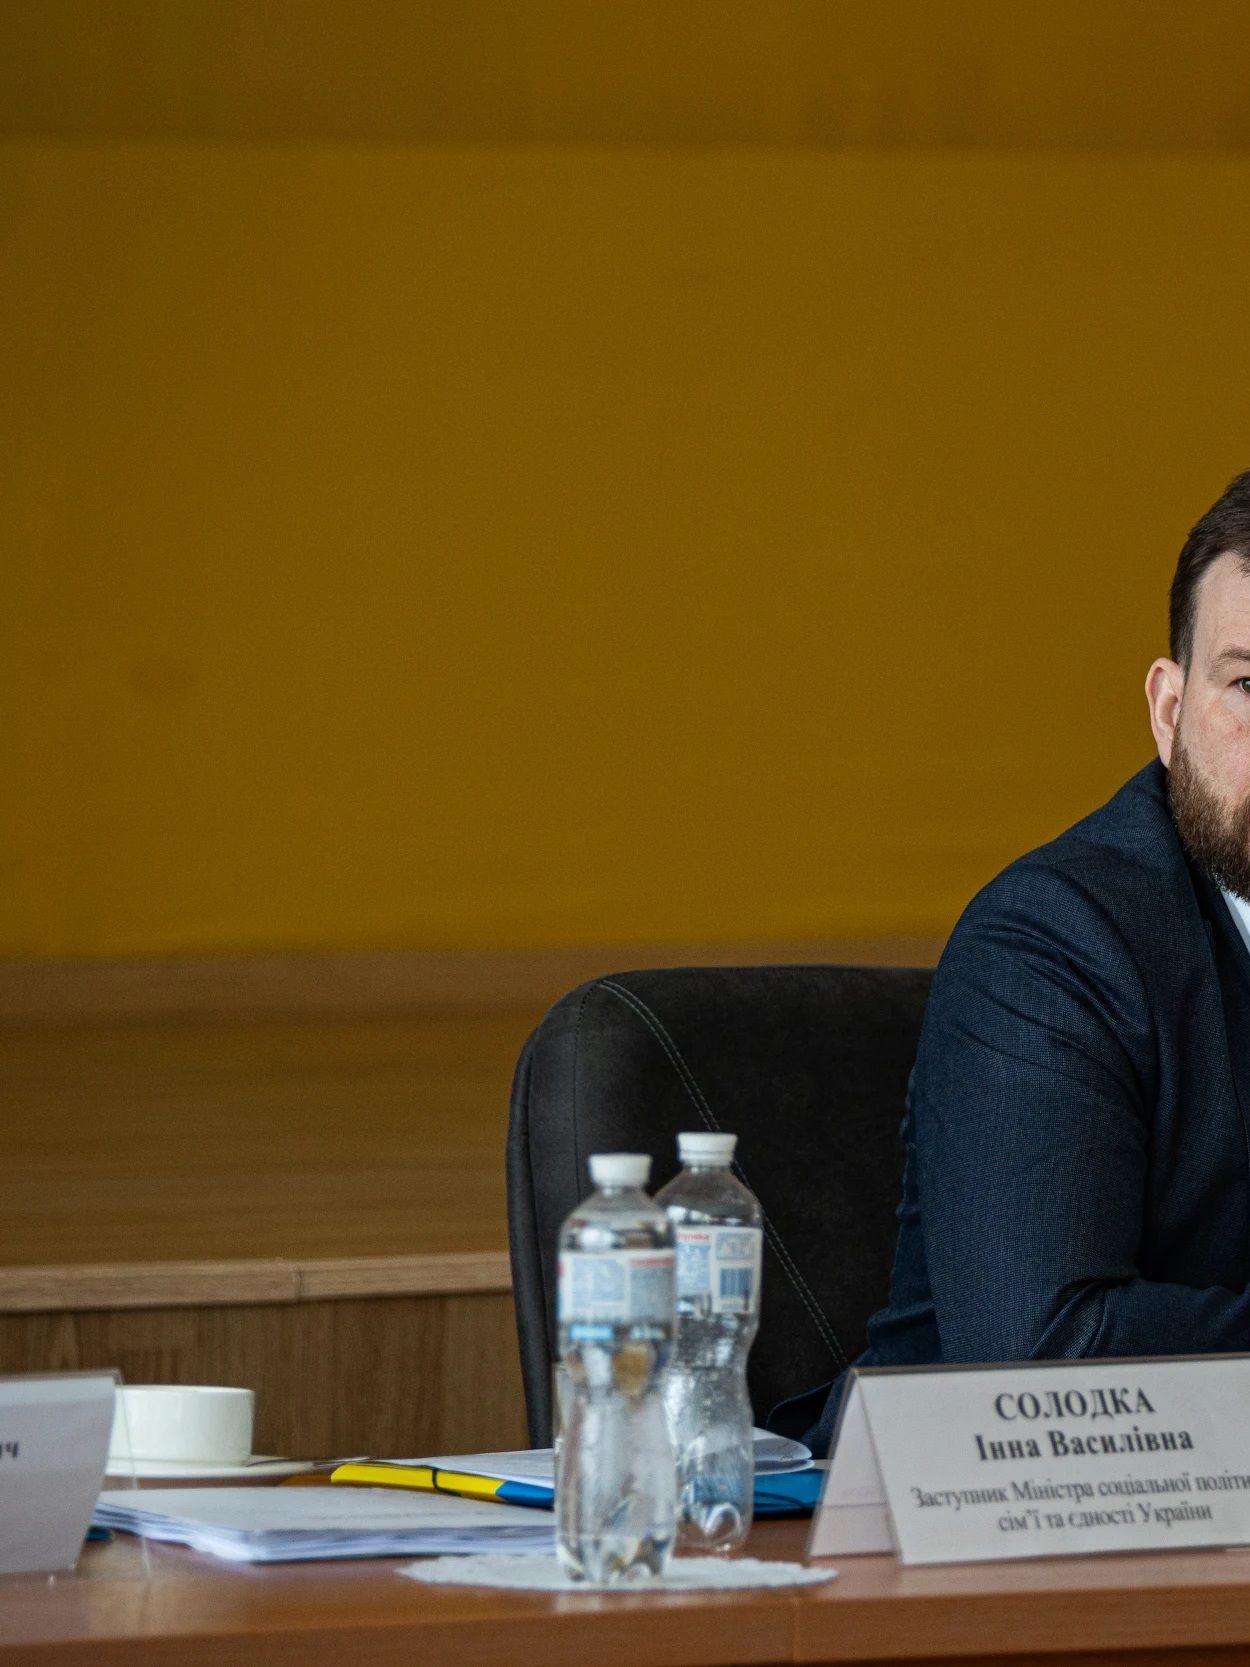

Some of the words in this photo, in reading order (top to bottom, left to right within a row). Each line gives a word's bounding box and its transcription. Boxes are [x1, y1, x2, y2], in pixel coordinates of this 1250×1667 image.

[994, 1387, 1156, 1422] СОЛОДКА
[974, 1432, 1042, 1462] Інна
[1046, 1425, 1195, 1457] Василівна
[910, 1486, 1010, 1512] Заступник
[1011, 1478, 1095, 1504] Міністра
[1098, 1472, 1193, 1498] соціальної
[1044, 1513, 1065, 1529] та
[1067, 1501, 1136, 1531] єдності
[1136, 1501, 1214, 1528] України
